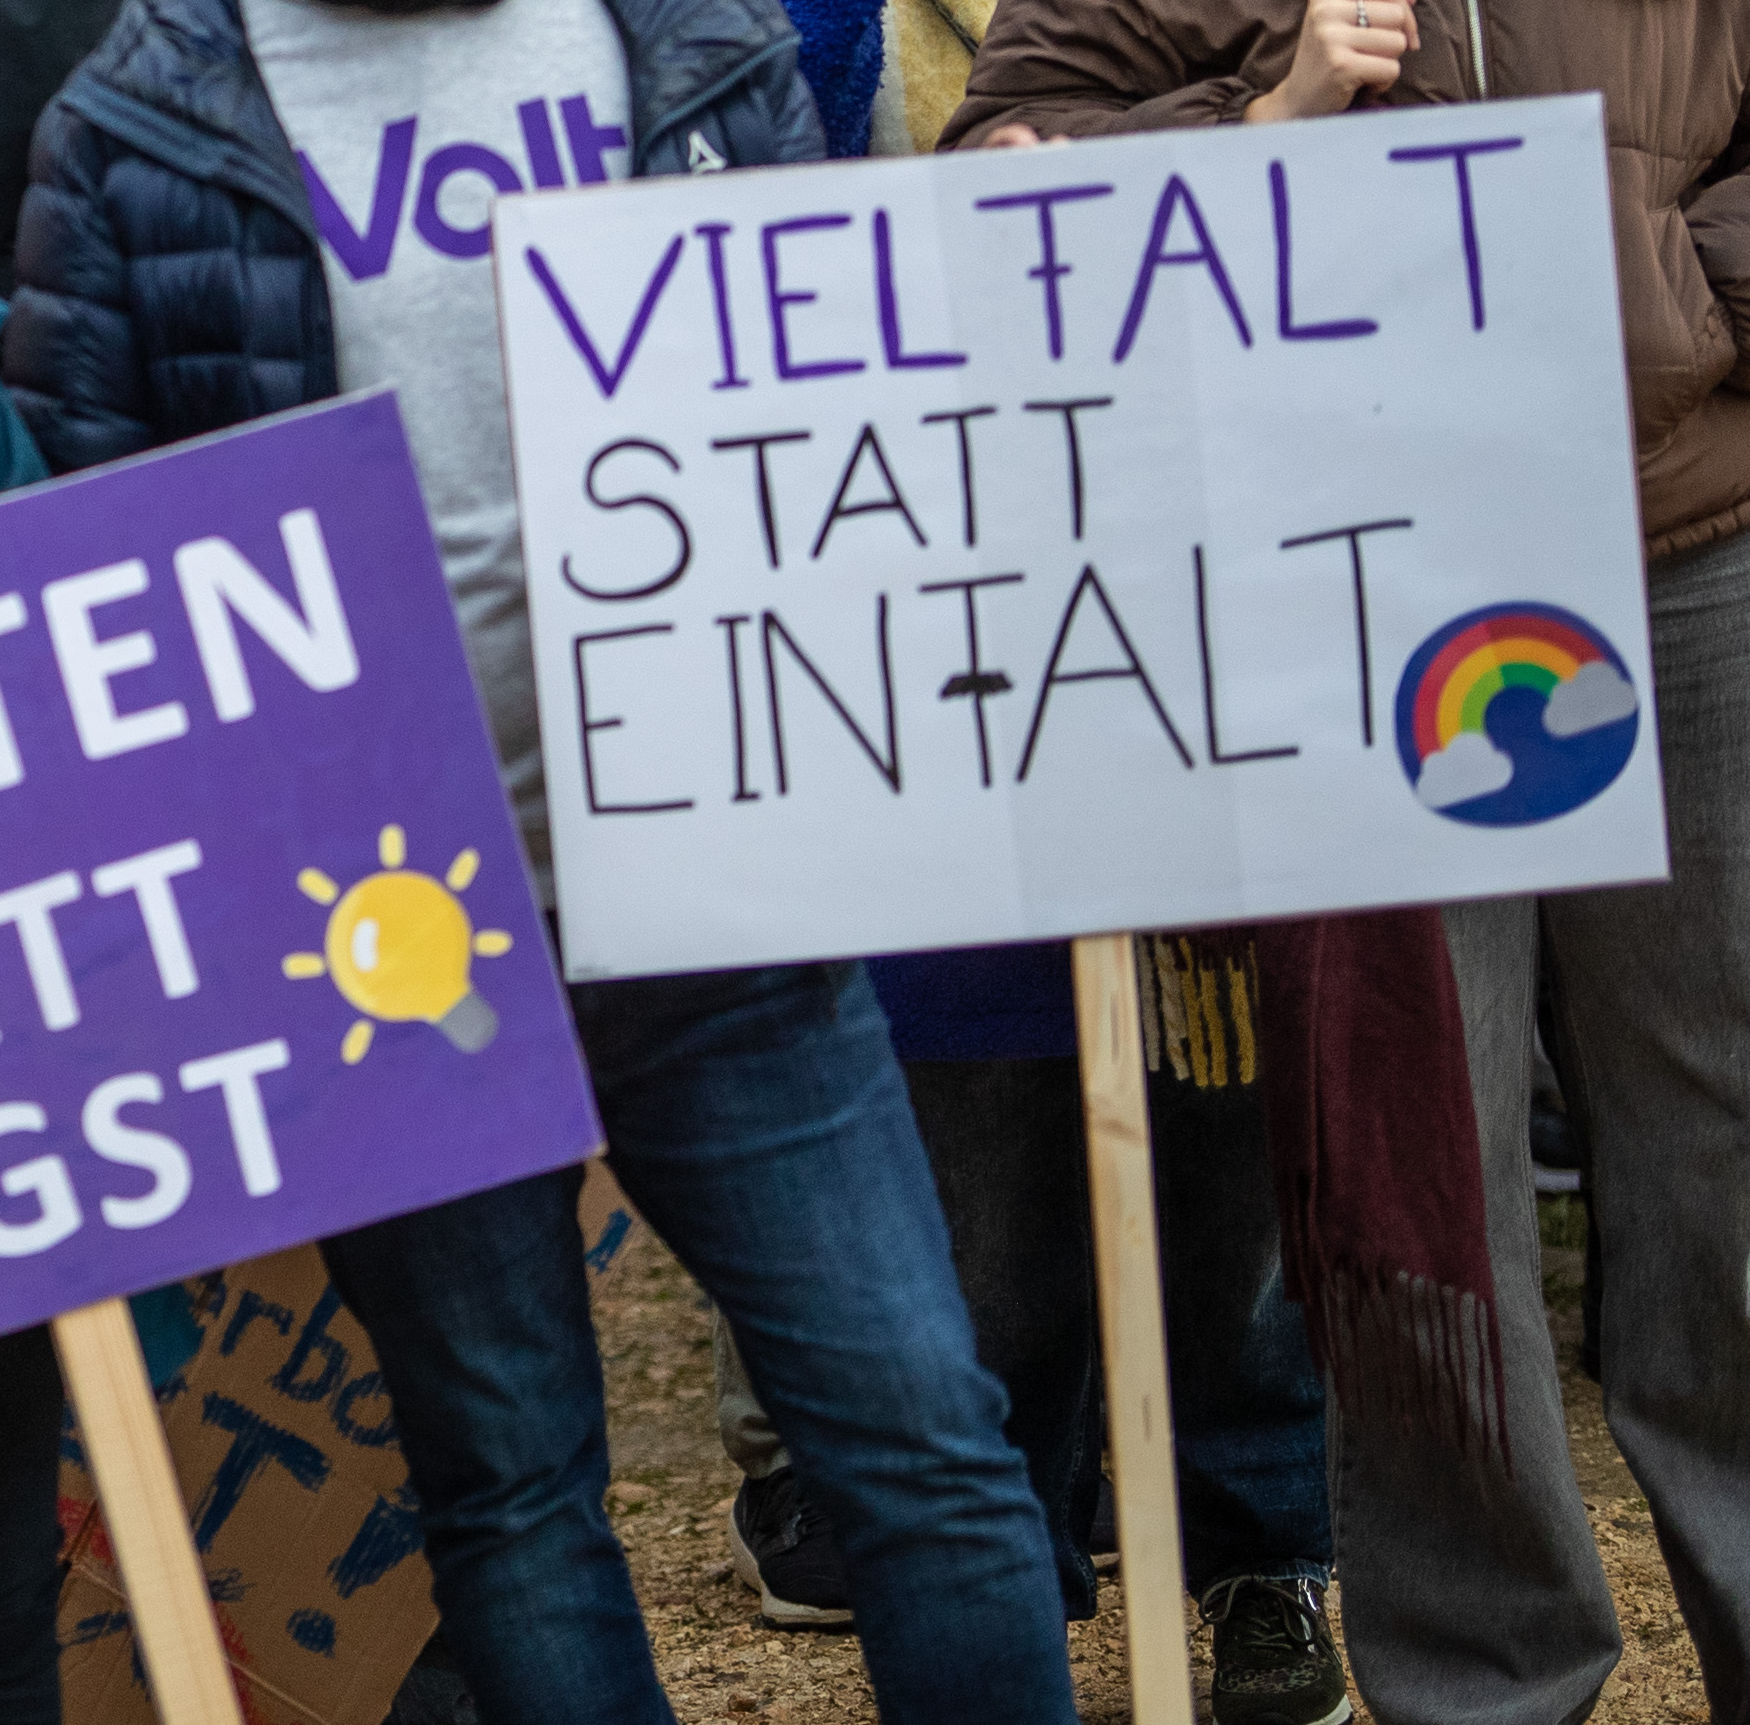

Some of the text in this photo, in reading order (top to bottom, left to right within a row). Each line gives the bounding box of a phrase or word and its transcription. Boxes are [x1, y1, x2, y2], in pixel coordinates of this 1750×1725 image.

[295, 93, 628, 284] Volt
[523, 135, 1525, 399] VIELFALT
[561, 395, 1115, 601] STATT
[572, 519, 1414, 816] EINFALT
